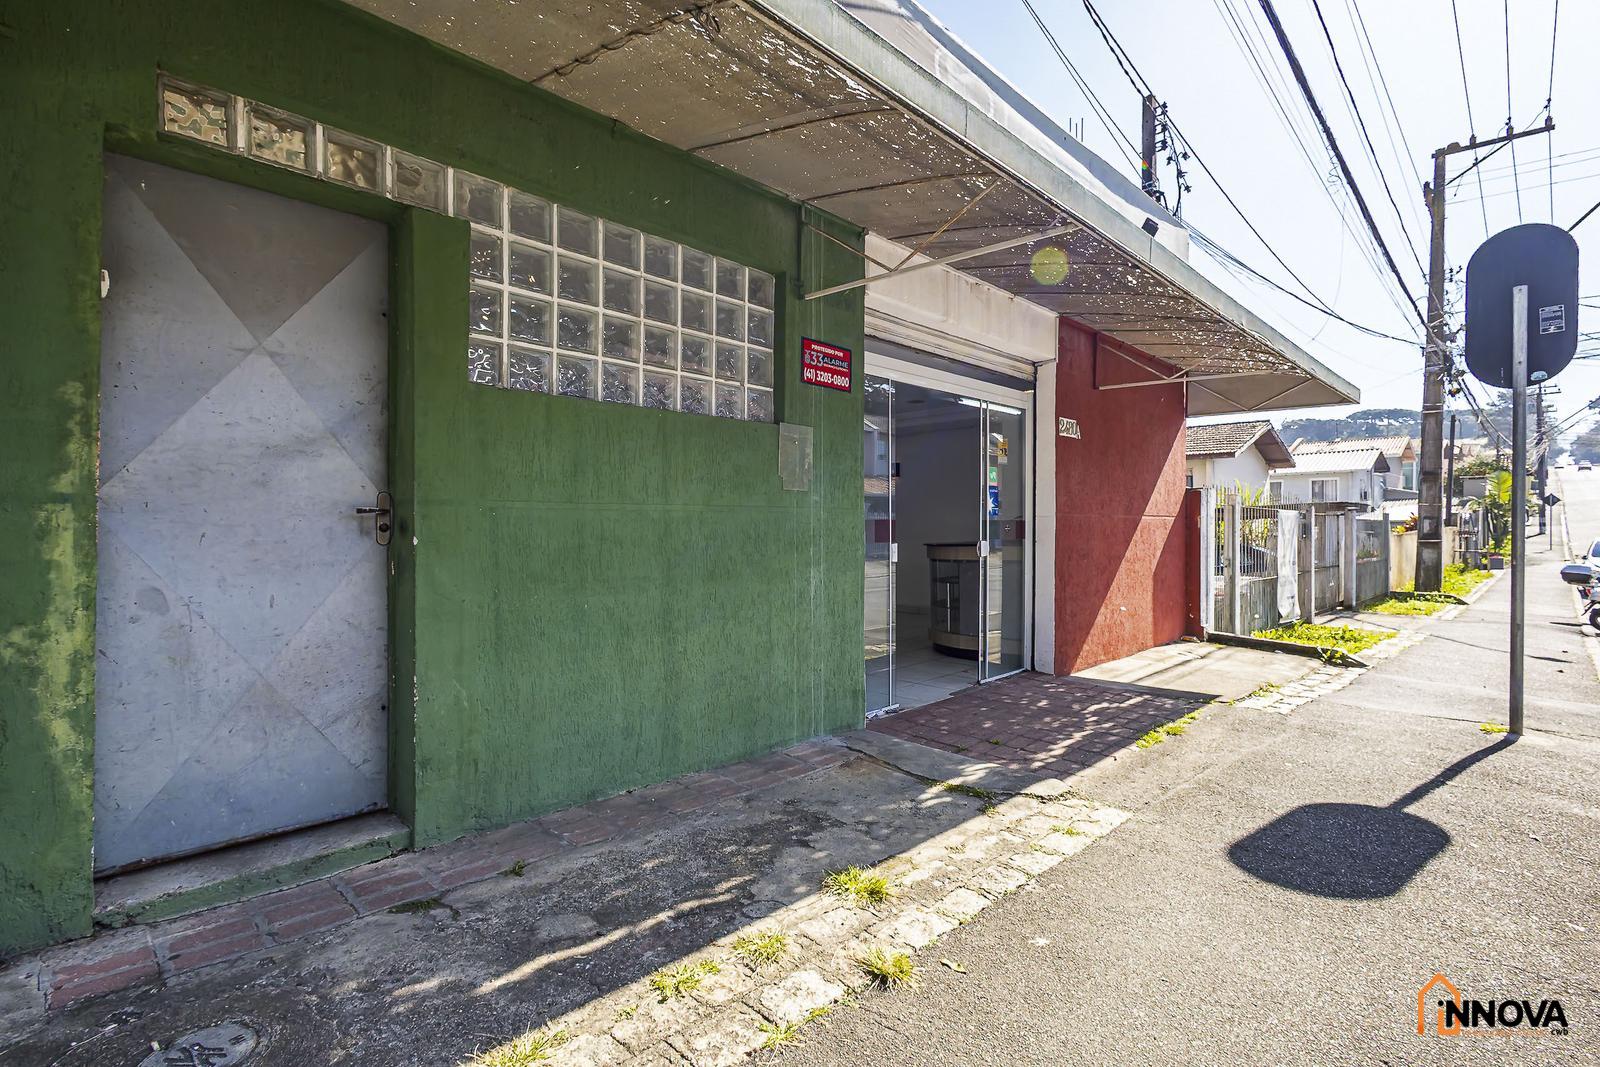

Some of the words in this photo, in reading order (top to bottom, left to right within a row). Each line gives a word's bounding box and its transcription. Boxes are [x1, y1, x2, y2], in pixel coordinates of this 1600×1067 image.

[824, 357, 848, 368] ALARME
[804, 367, 815, 382] (41)
[816, 371, 849, 387] 3203-0800
